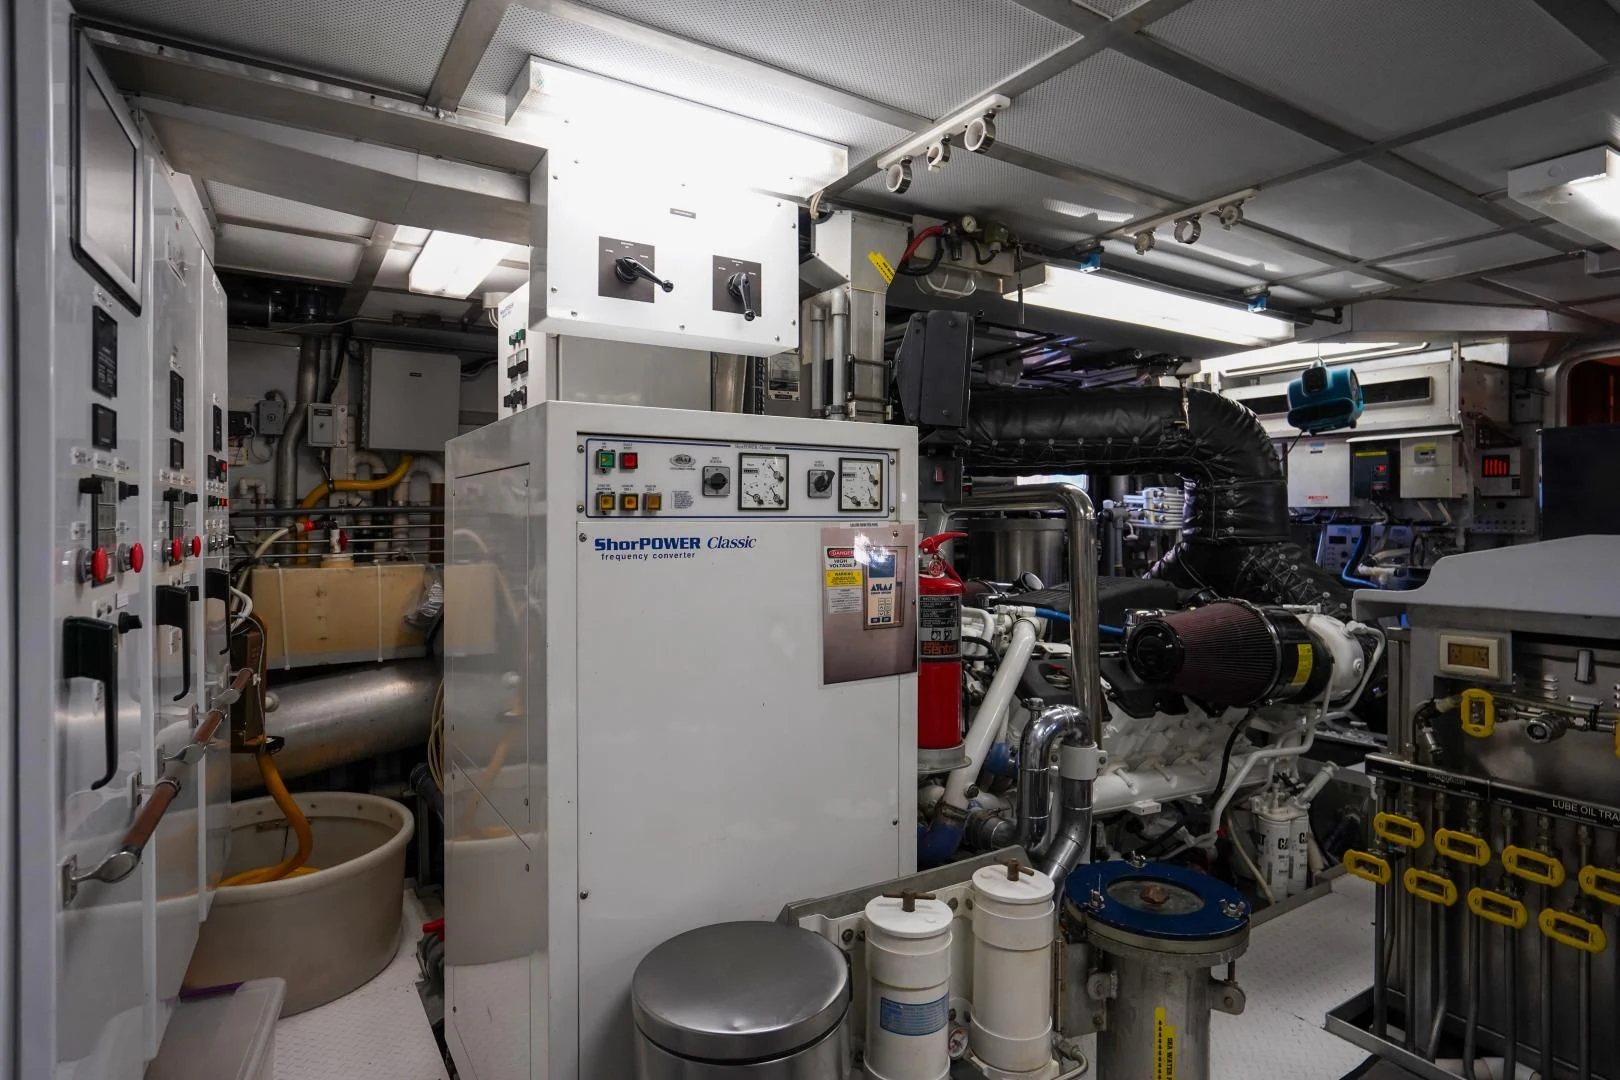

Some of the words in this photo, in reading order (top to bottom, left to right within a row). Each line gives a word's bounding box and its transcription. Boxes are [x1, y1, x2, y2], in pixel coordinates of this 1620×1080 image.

[594, 537, 701, 551] ShorPOWER
[707, 535, 757, 549] Classic
[601, 553, 649, 562] frequency
[1552, 799, 1578, 812] LUBE
[1580, 806, 1597, 817] OIL
